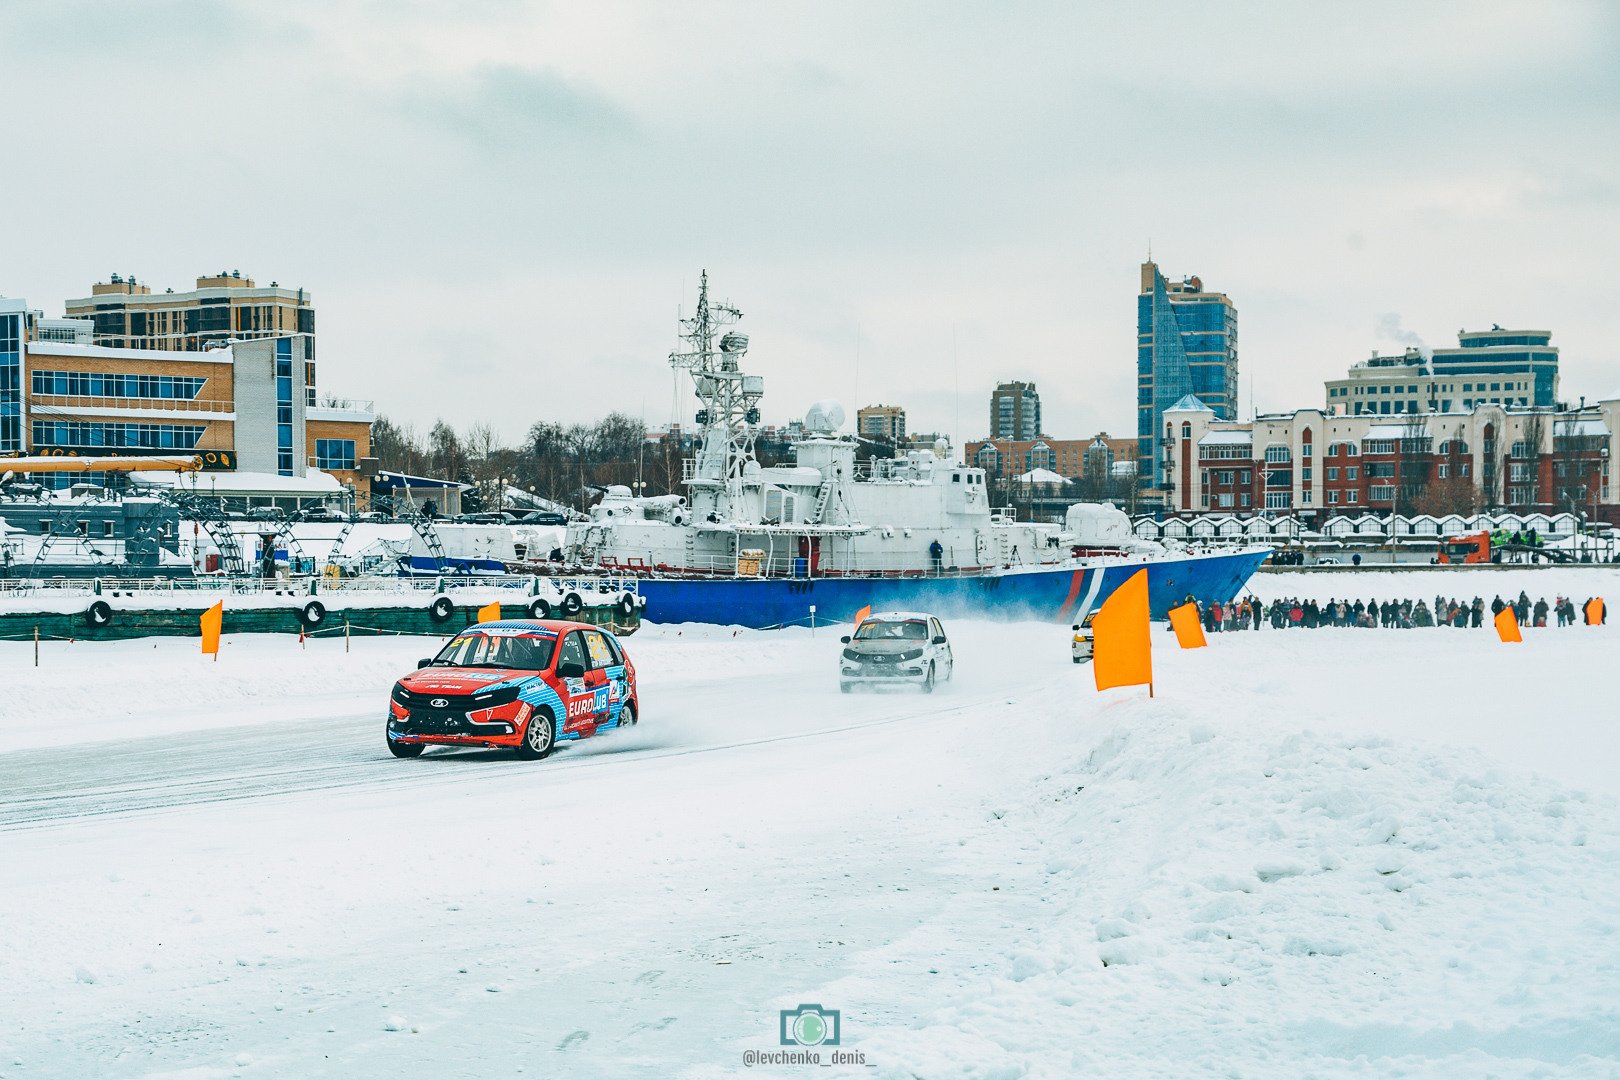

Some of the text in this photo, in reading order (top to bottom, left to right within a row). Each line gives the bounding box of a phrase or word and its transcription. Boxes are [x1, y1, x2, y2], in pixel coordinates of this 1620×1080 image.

[449, 637, 474, 648] 21
[588, 634, 607, 660] 21
[569, 694, 607, 718] EUROLUB
